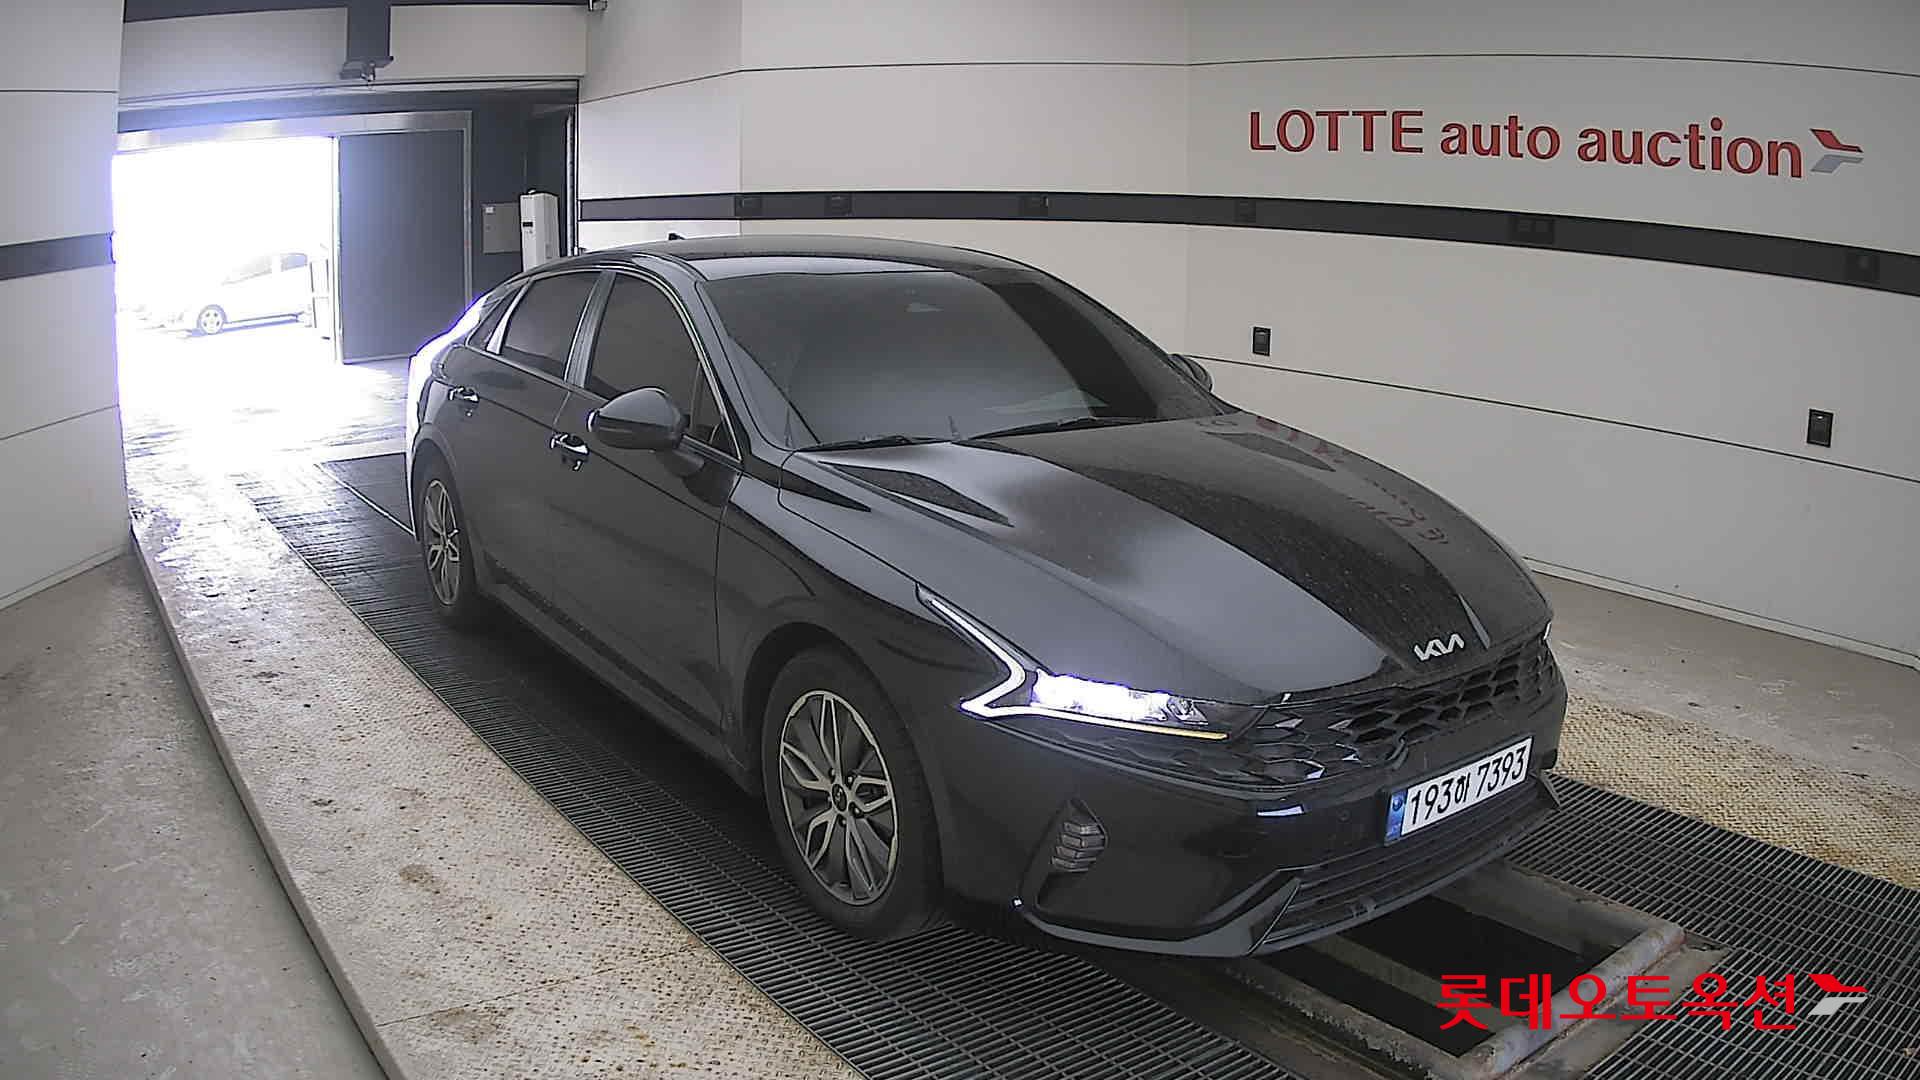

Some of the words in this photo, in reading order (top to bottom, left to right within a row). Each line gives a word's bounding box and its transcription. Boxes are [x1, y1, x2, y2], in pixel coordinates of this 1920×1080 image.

[1249, 110, 1424, 153] LOTTE
[1440, 115, 1561, 159] auto
[1577, 117, 1804, 178] auction
[1476, 745, 1527, 799] 7393
